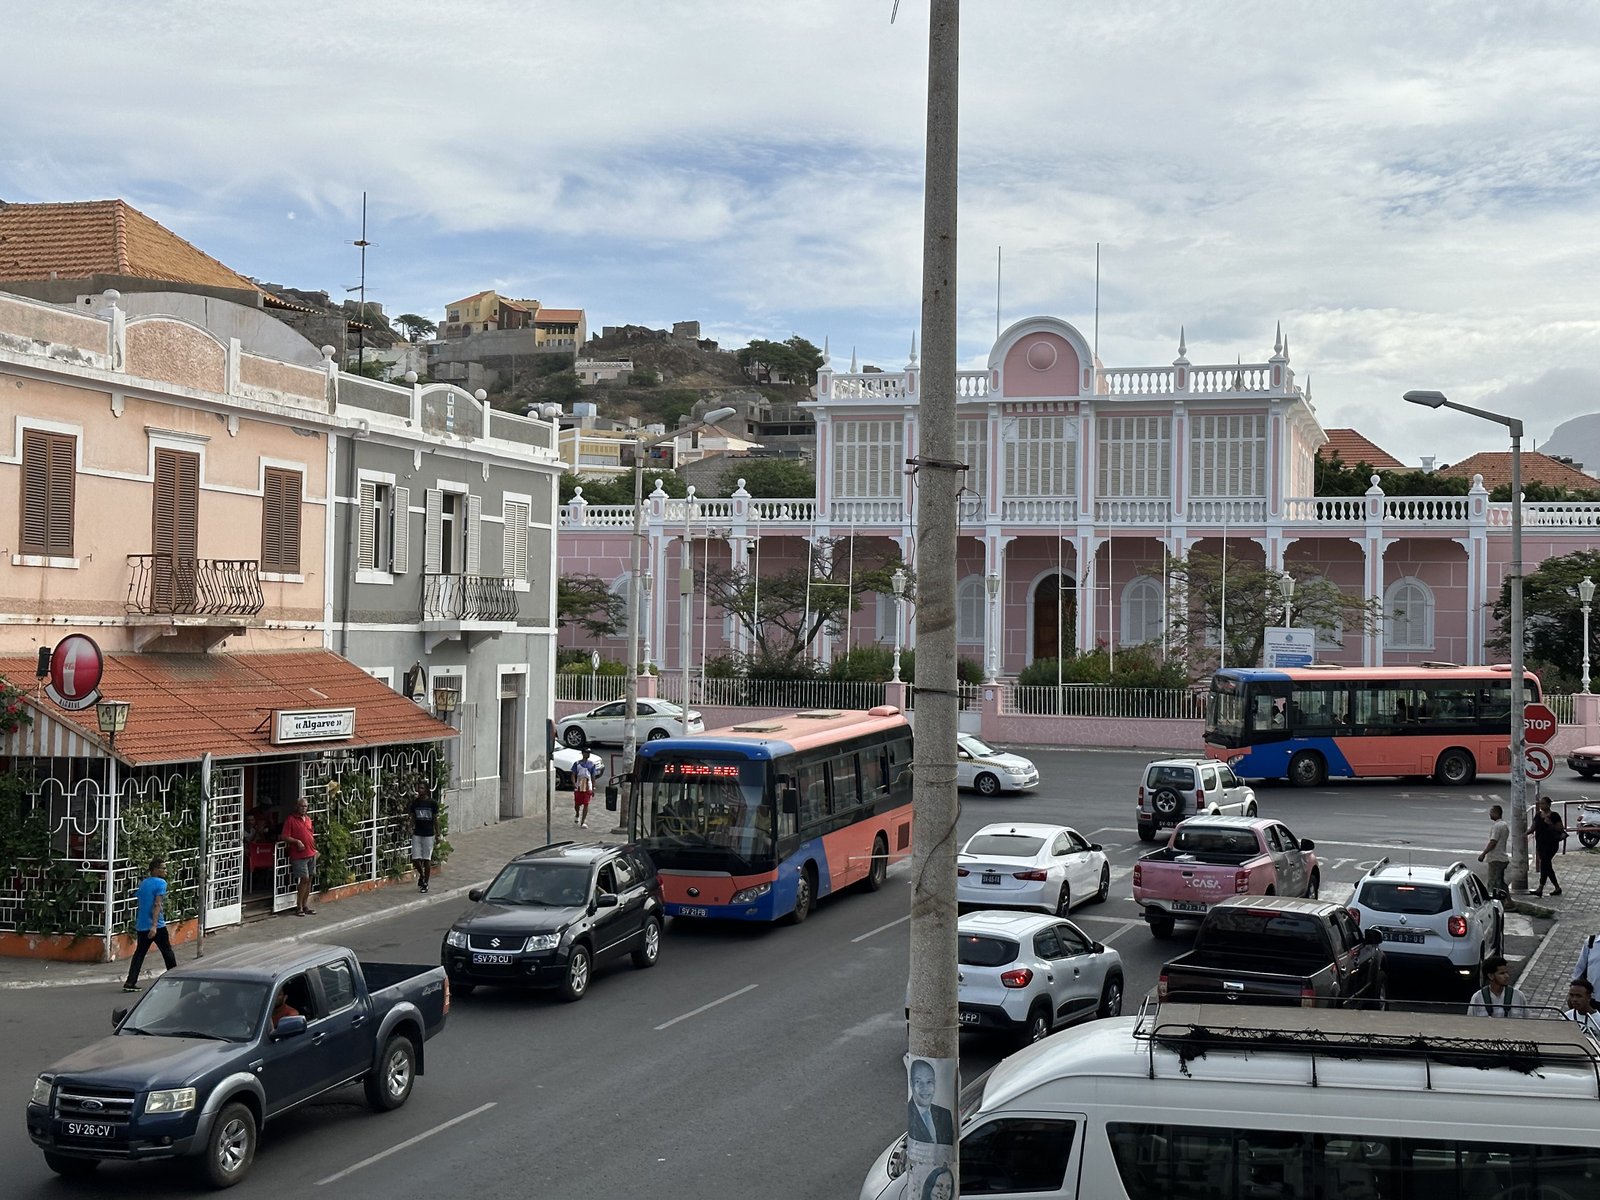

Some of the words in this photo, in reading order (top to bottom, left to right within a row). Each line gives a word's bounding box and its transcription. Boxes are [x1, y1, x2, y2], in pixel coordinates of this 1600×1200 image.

[303, 720, 335, 730] Algarve
[1523, 718, 1551, 730] STOP
[1192, 879, 1221, 889] CASA
